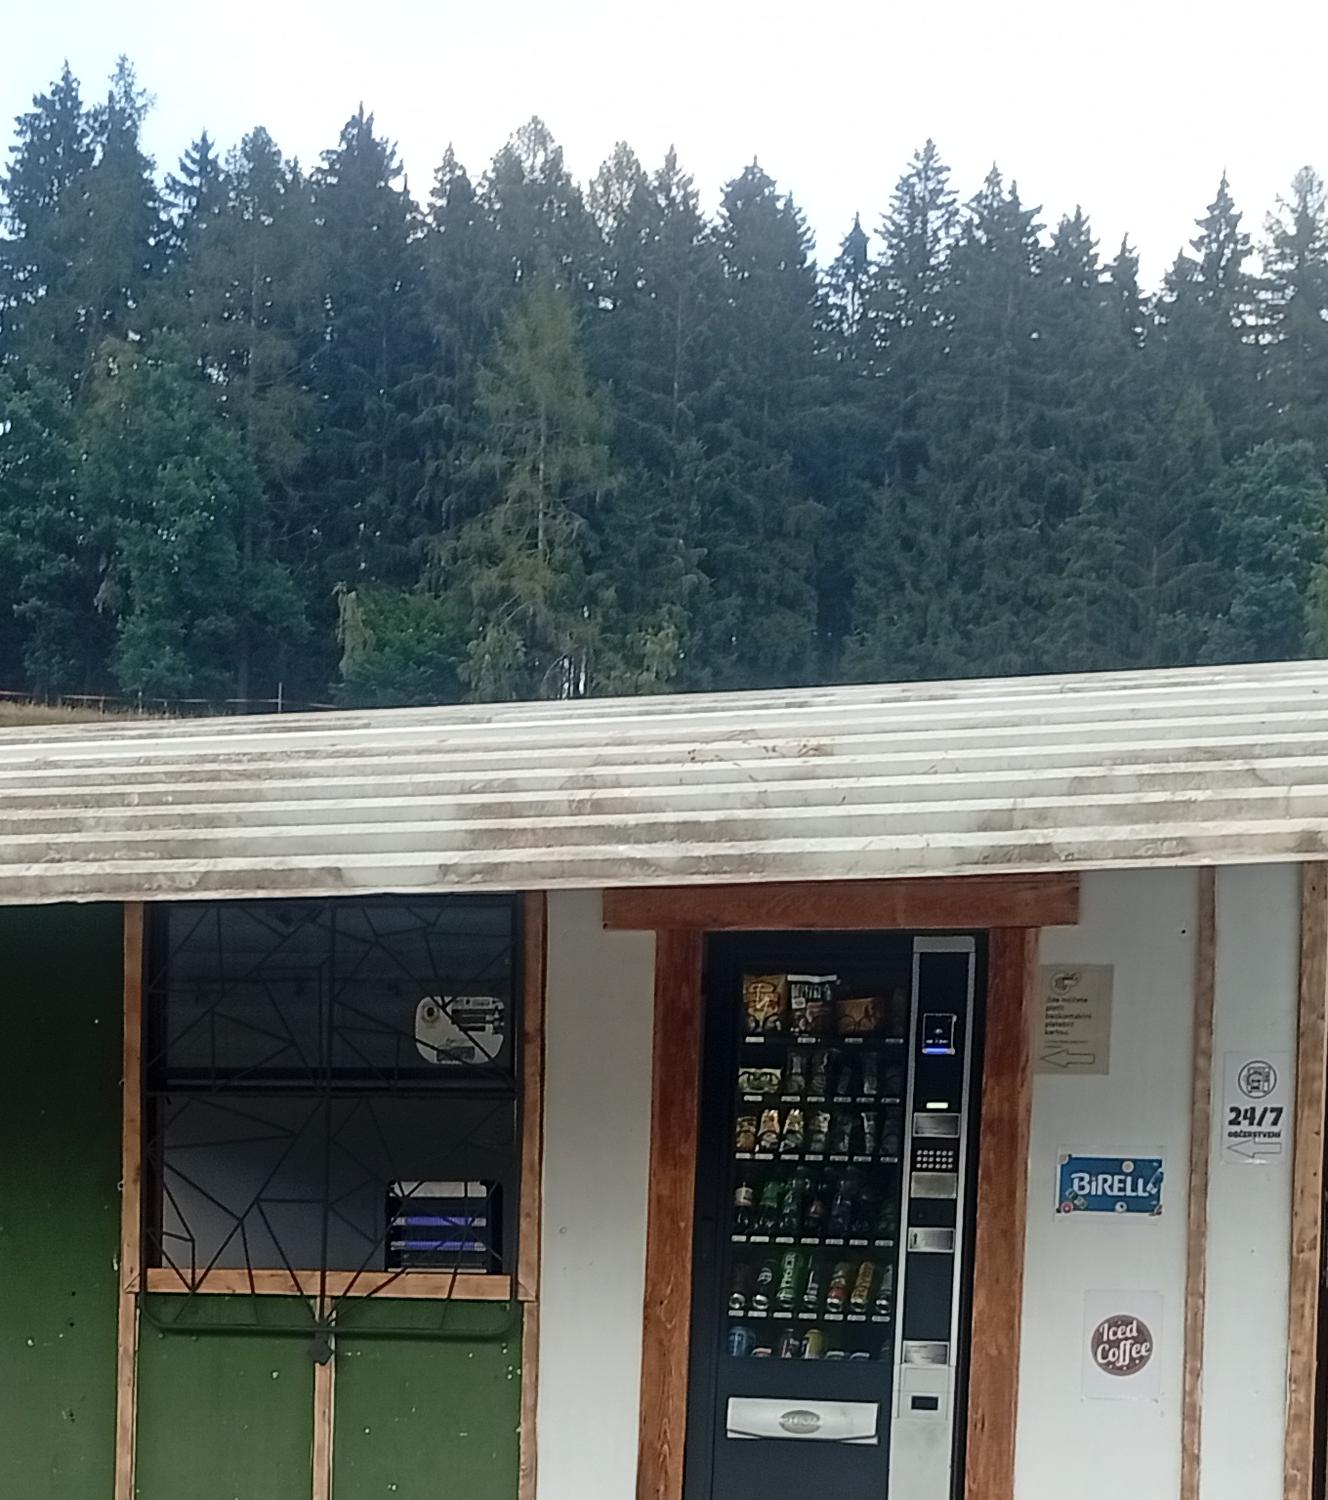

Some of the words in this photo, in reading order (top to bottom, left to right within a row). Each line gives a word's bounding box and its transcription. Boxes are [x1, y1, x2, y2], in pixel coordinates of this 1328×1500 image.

[1228, 1106, 1284, 1127] 24/7
[1099, 1320, 1138, 1342] Iced
[1096, 1340, 1150, 1367] Coffee
